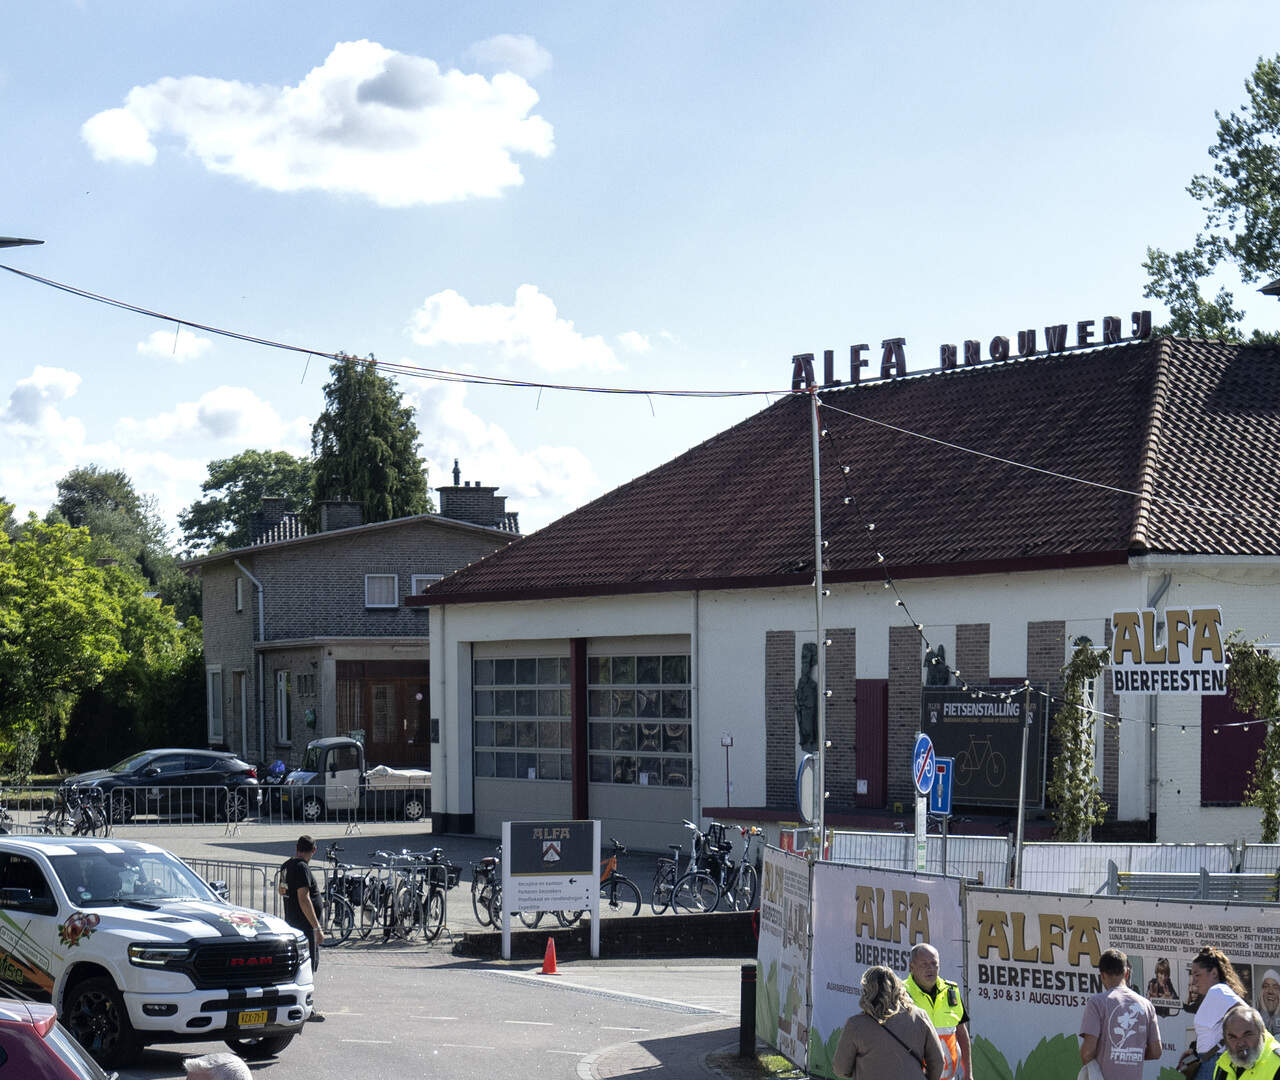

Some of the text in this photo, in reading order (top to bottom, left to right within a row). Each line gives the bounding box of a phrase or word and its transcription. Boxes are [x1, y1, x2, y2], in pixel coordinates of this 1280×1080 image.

[791, 336, 906, 392] ALFA
[1112, 608, 1222, 665] ALFA
[1114, 669, 1224, 693] BIERFEESTEN
[943, 702, 1020, 717] FIETSENSTALLING
[532, 827, 571, 840] ALFA
[855, 885, 931, 946] ALFA
[976, 909, 1102, 969] ALFA
[231, 956, 273, 967] RAM
[977, 963, 1103, 994] BIERFEESTEN
[978, 987, 991, 1000] 29,
[993, 988, 1004, 1000] 30
[1006, 989, 1013, 1001] &
[1015, 991, 1026, 1002] 31
[1028, 991, 1079, 1008] AUGUSTUS
